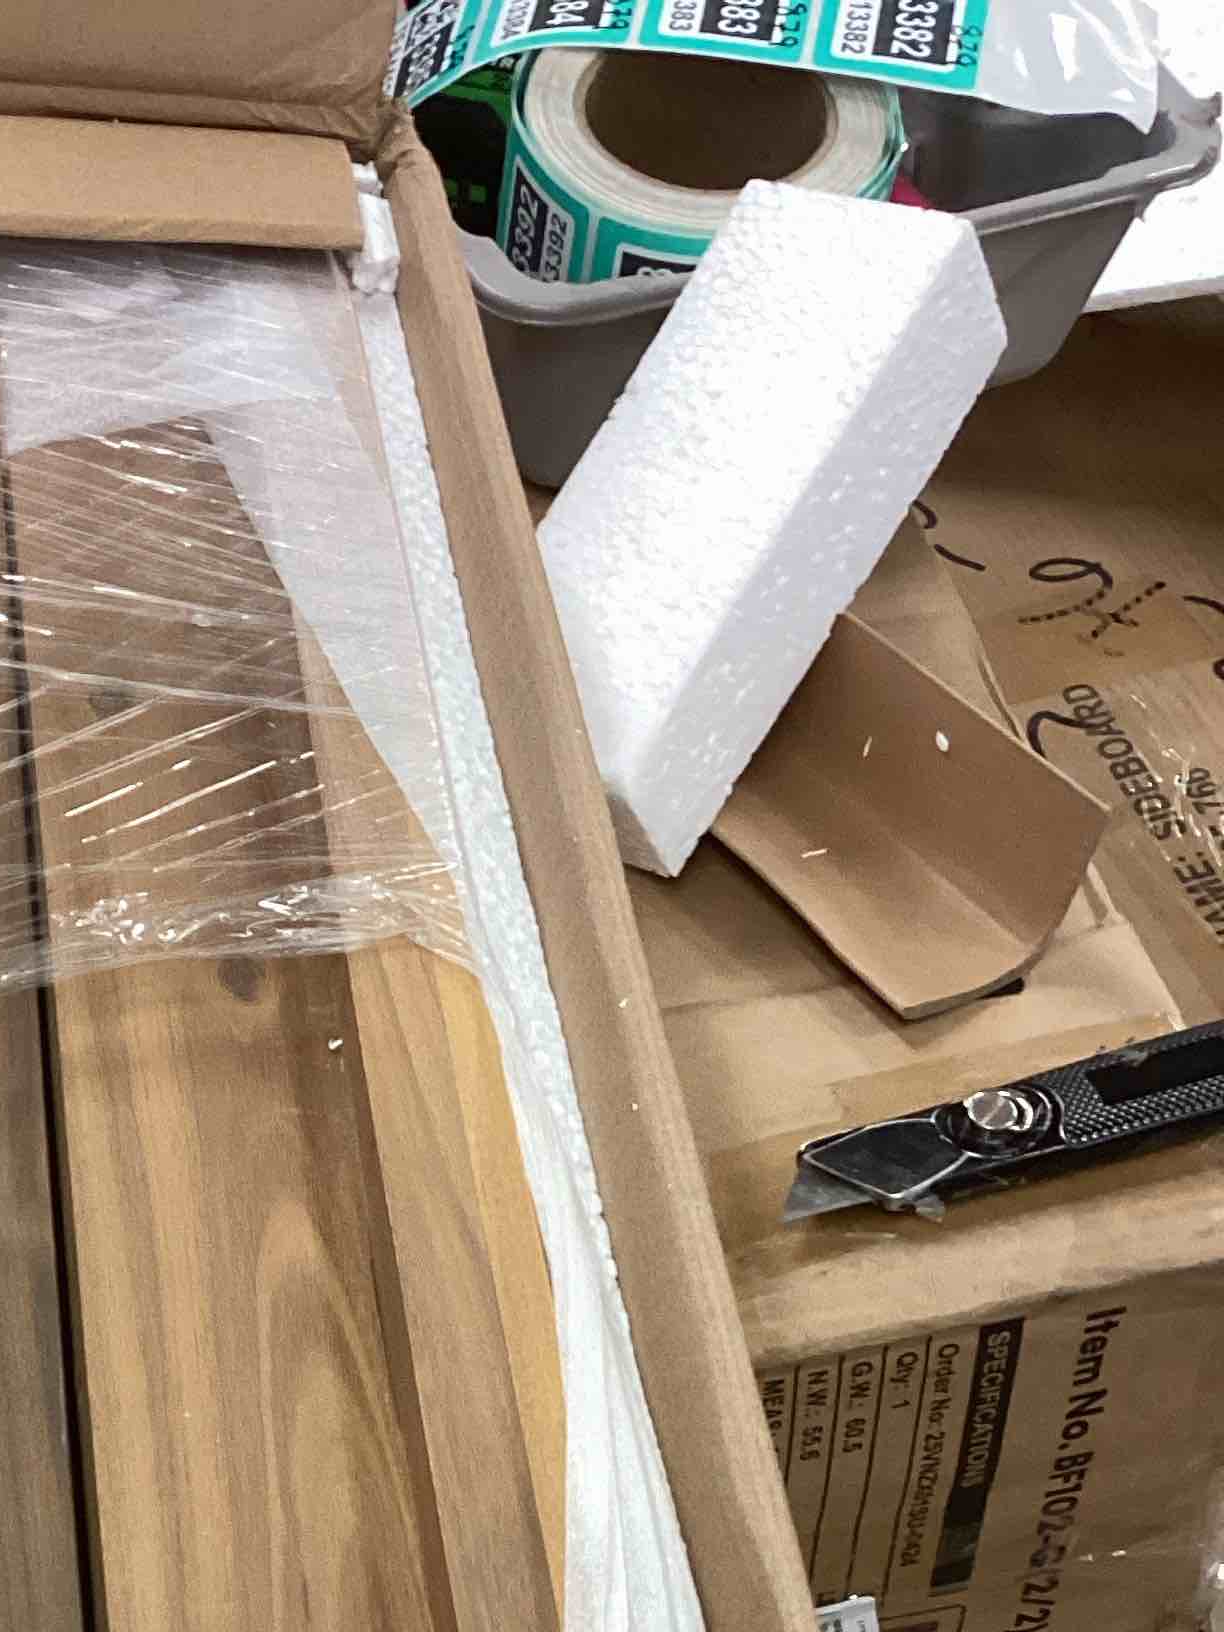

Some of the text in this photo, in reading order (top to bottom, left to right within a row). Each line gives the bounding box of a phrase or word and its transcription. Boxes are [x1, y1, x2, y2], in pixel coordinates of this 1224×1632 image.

[1063, 684, 1187, 841] SIDEBOARD
[1173, 851, 1224, 938] AME:
[890, 1352, 919, 1390] Qty:
[933, 1343, 961, 1394] Order
[1073, 1306, 1127, 1386] Item
[960, 1331, 1012, 1488] SPECIFICATIONS
[1057, 1388, 1108, 1450] No.
